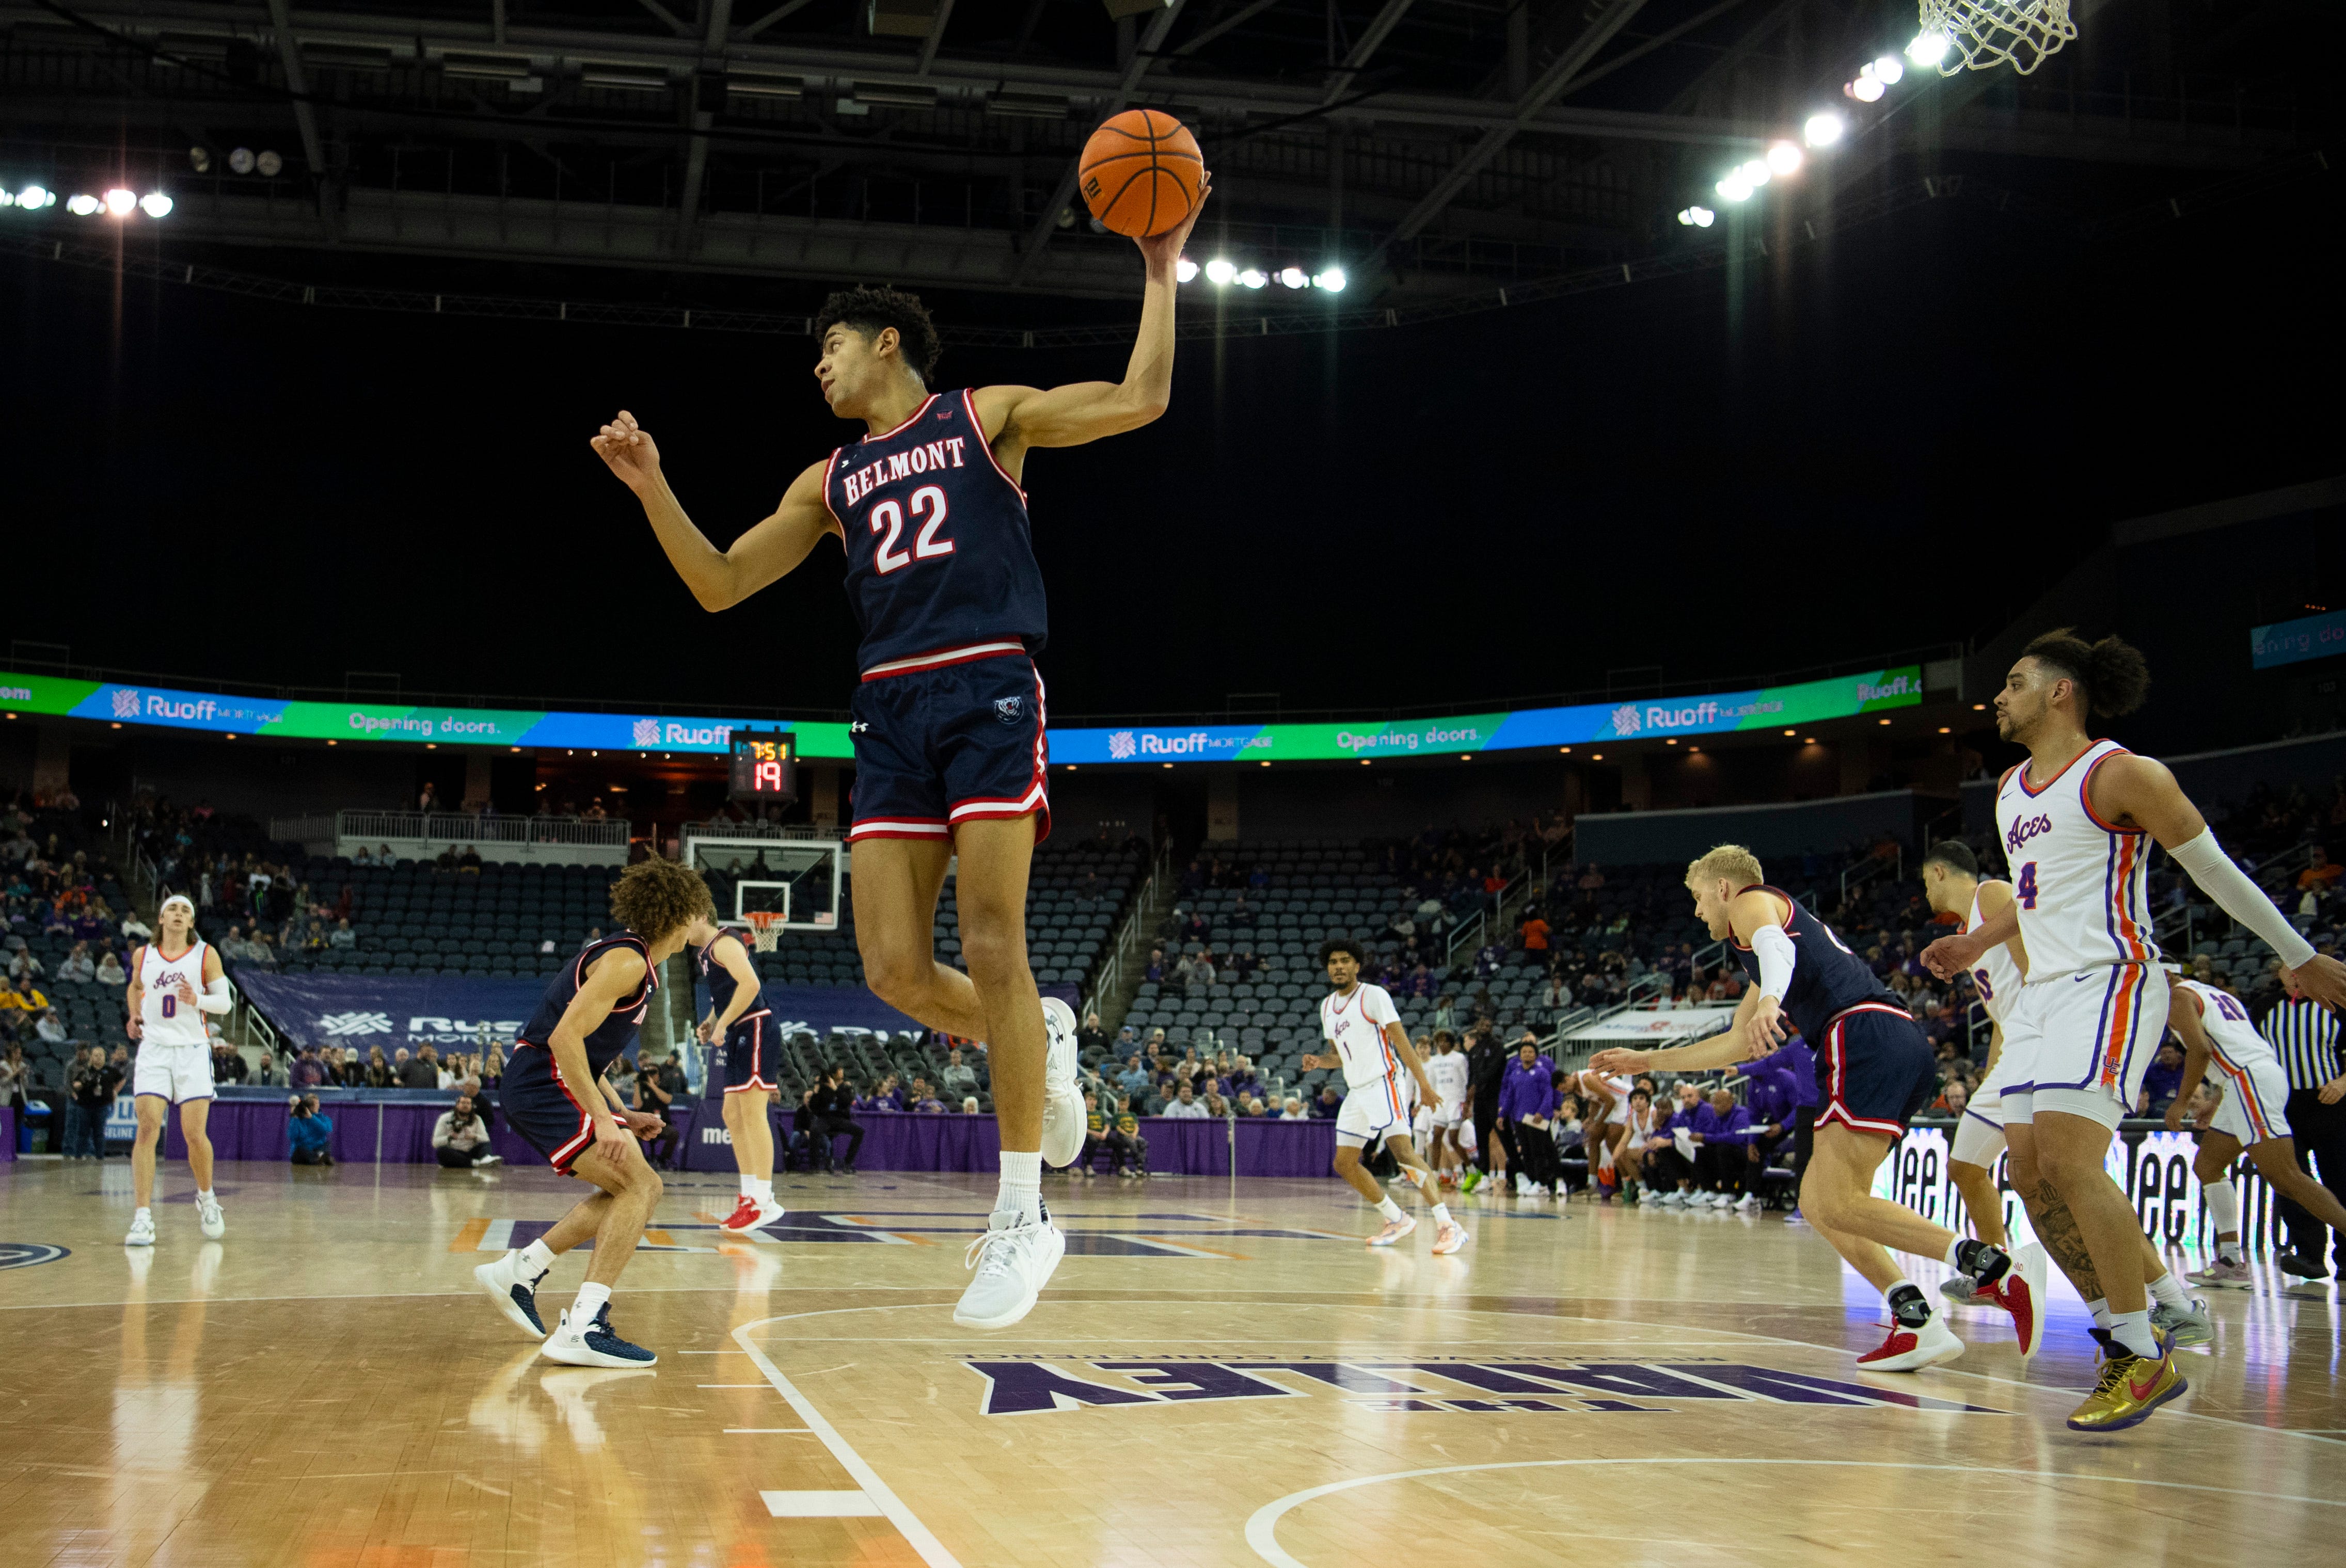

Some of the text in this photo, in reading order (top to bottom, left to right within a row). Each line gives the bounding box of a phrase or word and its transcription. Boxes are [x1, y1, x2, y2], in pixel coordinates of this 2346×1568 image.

[843, 436, 965, 508] BELMONT
[868, 483, 956, 577] 22
[147, 695, 216, 721] Ruoff
[1647, 702, 1718, 728] Ruoff
[349, 713, 501, 736] Opening doors.
[665, 724, 734, 745] Ruoff
[751, 741, 786, 761] 7:51
[1142, 733, 1208, 754] Ruoff
[1337, 726, 1481, 752] Opening doors.
[754, 761, 781, 791] 19
[2007, 813, 2052, 854] Aces
[2017, 861, 2038, 910] 4
[153, 971, 185, 989] Aces
[162, 994, 177, 1019] 0
[409, 1016, 525, 1034] Ruo
[1335, 1019, 1350, 1039] Aces
[1343, 1041, 1352, 1061] 1
